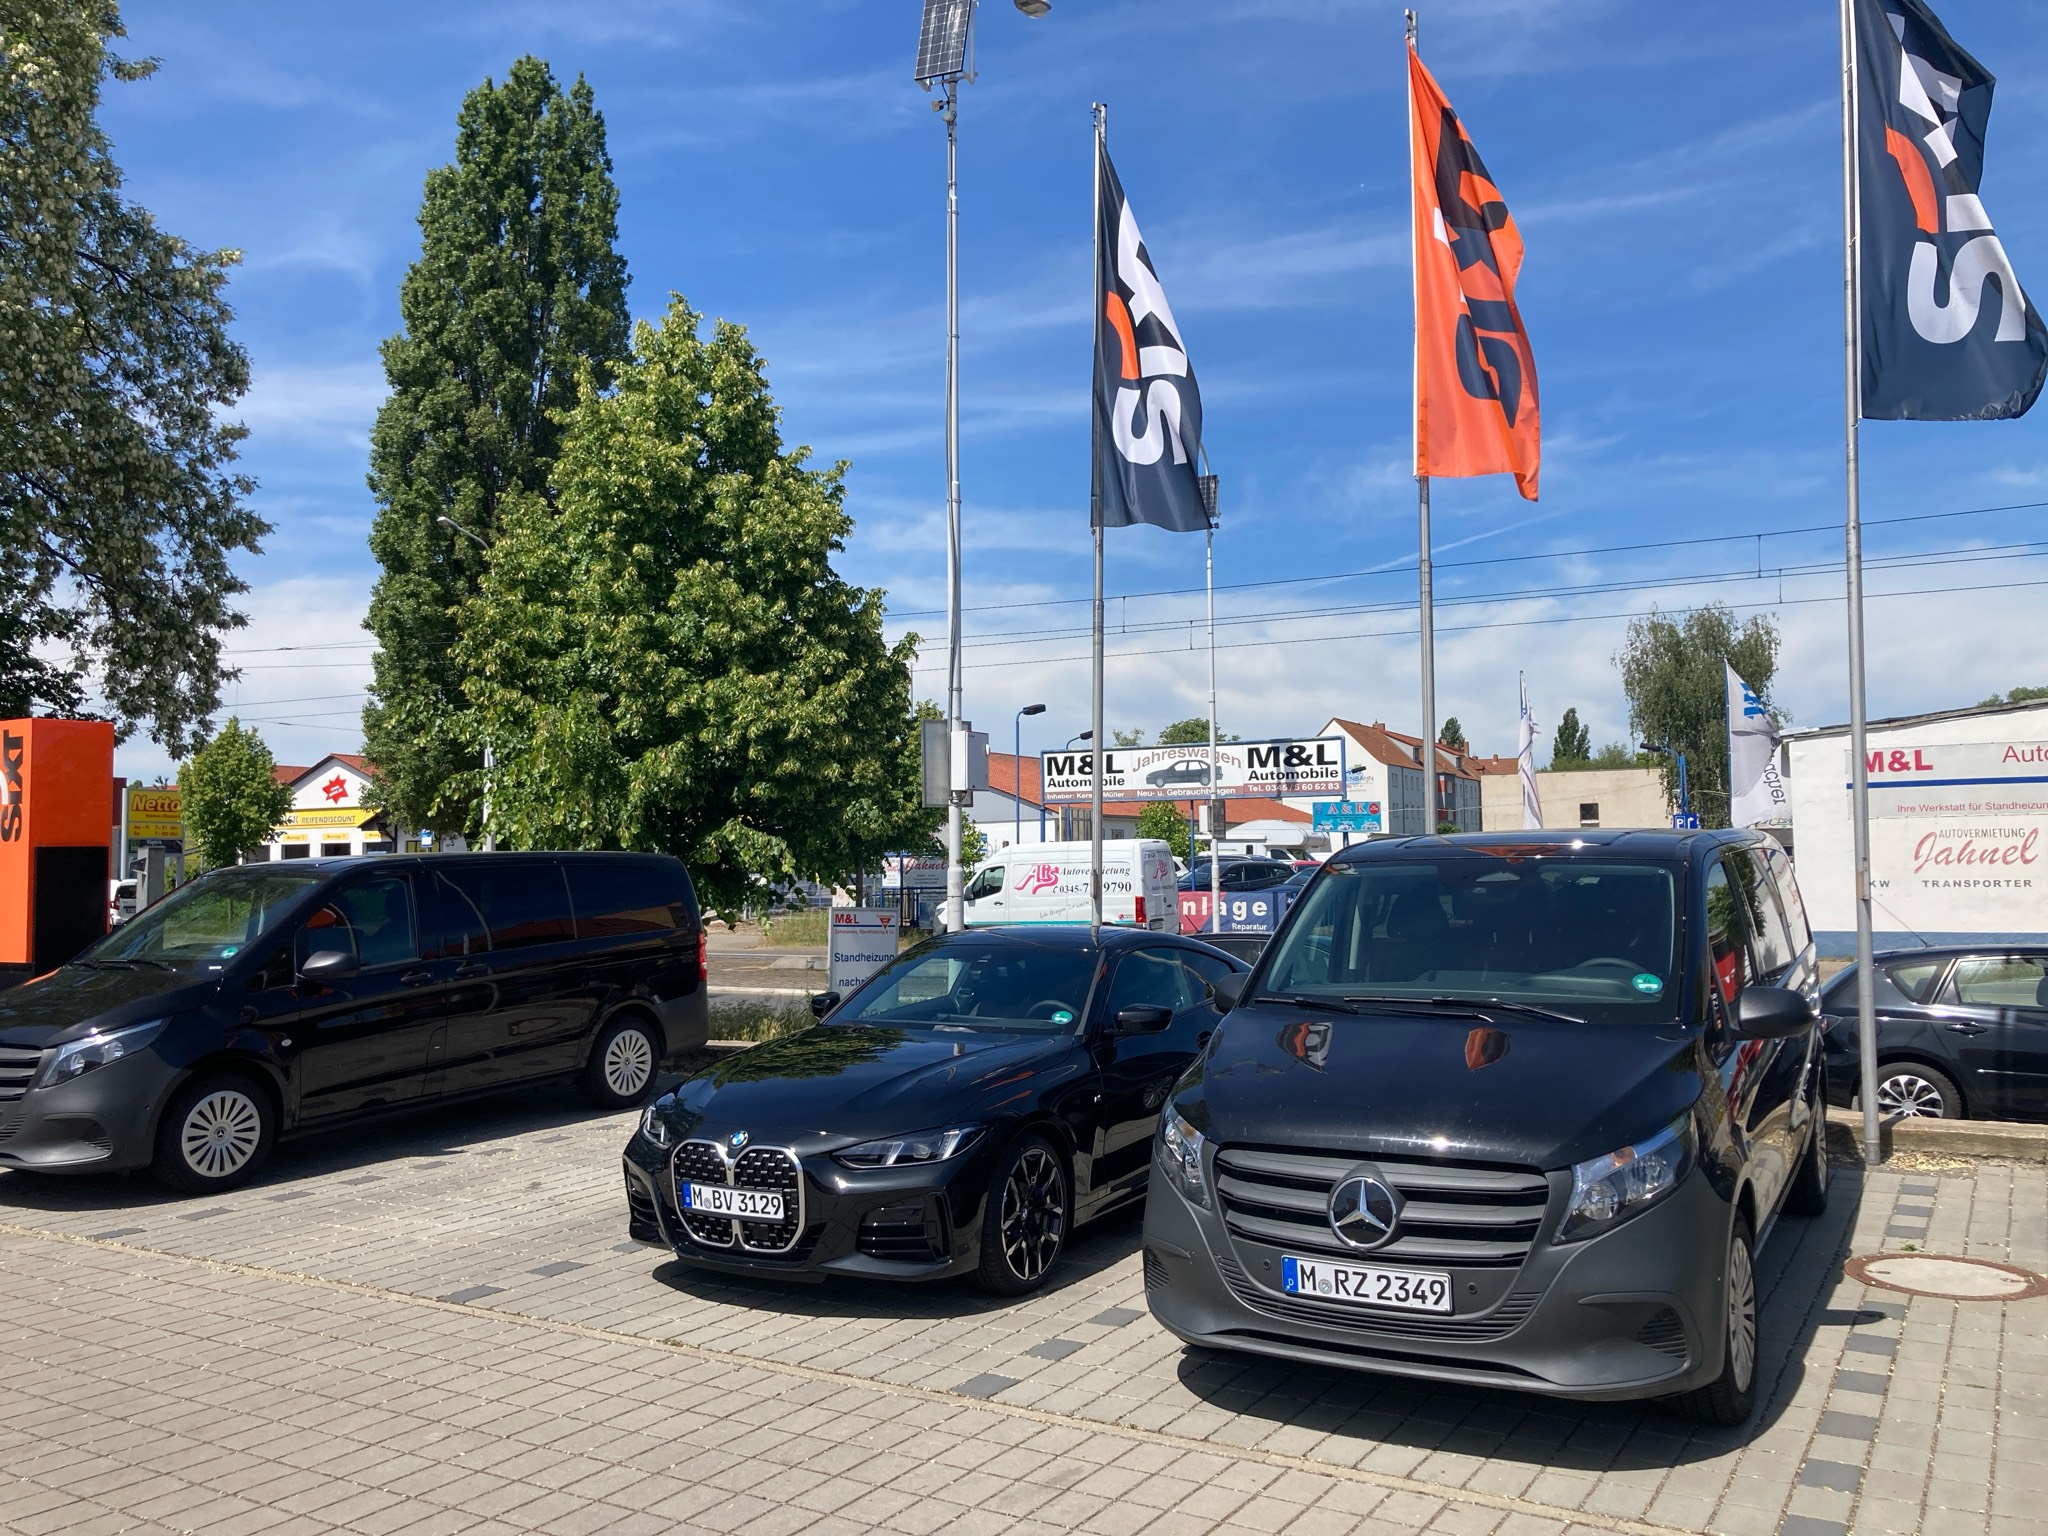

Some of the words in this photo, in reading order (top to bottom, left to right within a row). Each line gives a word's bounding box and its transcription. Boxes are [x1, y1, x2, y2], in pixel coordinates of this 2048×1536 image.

[1247, 744, 1338, 769] M&L
[1866, 749, 1934, 773] M&L
[2002, 745, 2048, 763] Aut
[1047, 775, 1125, 788] Autombile
[1248, 767, 1339, 781] Automobile
[1, 729, 24, 842] SIXT
[1265, 784, 1288, 792] 0345
[1301, 783, 1312, 791] 60
[1314, 782, 1325, 790] 62
[1328, 782, 1340, 790] 83
[1137, 789, 1156, 797] Neu-
[131, 794, 182, 812] Netto
[1328, 803, 1338, 814] A
[1342, 803, 1352, 814] &
[1356, 803, 1367, 814] K
[1897, 804, 1917, 812] Ihre
[1918, 803, 1966, 812] Werkstatt
[1968, 802, 1982, 811] für
[1985, 801, 2048, 810] Standheizun
[301, 815, 356, 824] REIFENDISCOUNT
[1676, 818, 1684, 828] P
[1939, 827, 2026, 839] AUTOVERMIETUNG
[1913, 827, 2039, 874] Jahnel
[1060, 866, 1131, 876] Autoveietung
[1059, 882, 1132, 893] 0345-79790
[1869, 880, 1890, 888] KW
[1922, 879, 2033, 888] TRANSPORTER
[1182, 896, 1268, 921] nlage
[834, 913, 859, 924] M&L
[1231, 922, 1267, 931] Reparatur
[692, 1186, 703, 1207] M
[712, 1190, 733, 1211] BV
[738, 1193, 781, 1215] 3129
[1300, 1264, 1317, 1291] M
[1334, 1268, 1370, 1299] RZ
[1376, 1274, 1446, 1306] 2349
